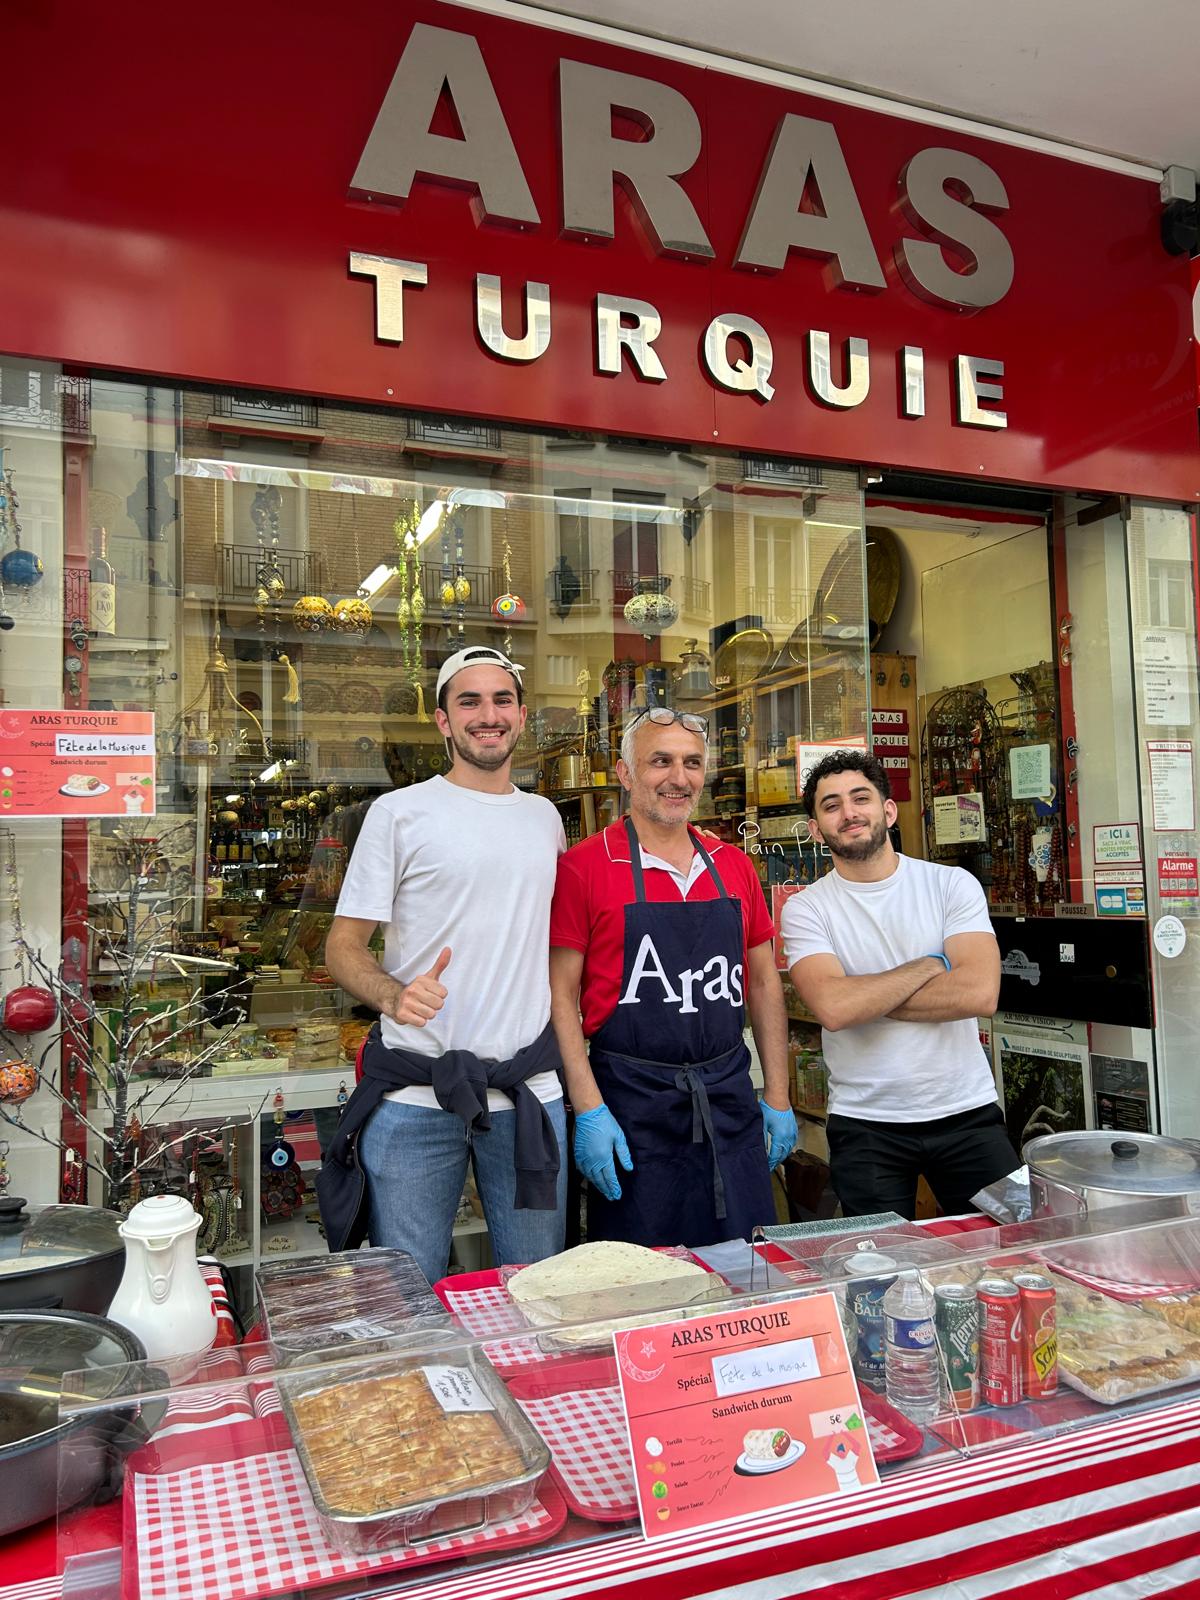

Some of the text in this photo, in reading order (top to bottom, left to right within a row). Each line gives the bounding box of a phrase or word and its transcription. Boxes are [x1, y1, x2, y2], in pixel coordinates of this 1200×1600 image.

[349, 21, 1016, 312] ARAS
[348, 251, 1008, 430] TURQUIE
[30, 715, 118, 727] ARAS TURQUIE
[871, 713, 901, 723] ARAS
[58, 738, 85, 752] Fête
[86, 743, 98, 751] de
[99, 739, 108, 751] la
[873, 736, 906, 745] RQUIE
[737, 820, 785, 857] Pain
[1109, 829, 1123, 839] ICI
[1162, 860, 1194, 871] Alarme
[1061, 906, 1087, 915] POUSSEZ
[618, 933, 744, 1014] Aras
[1032, 1016, 1056, 1026] VISION
[853, 1301, 885, 1317] BALE
[671, 1311, 791, 1348] ARAS TURQUIE
[751, 1367, 763, 1377] de
[766, 1361, 775, 1373] la
[677, 1374, 713, 1391] Spécial
[712, 1394, 793, 1419] Sandwich durum
[829, 1414, 842, 1425] 5€
